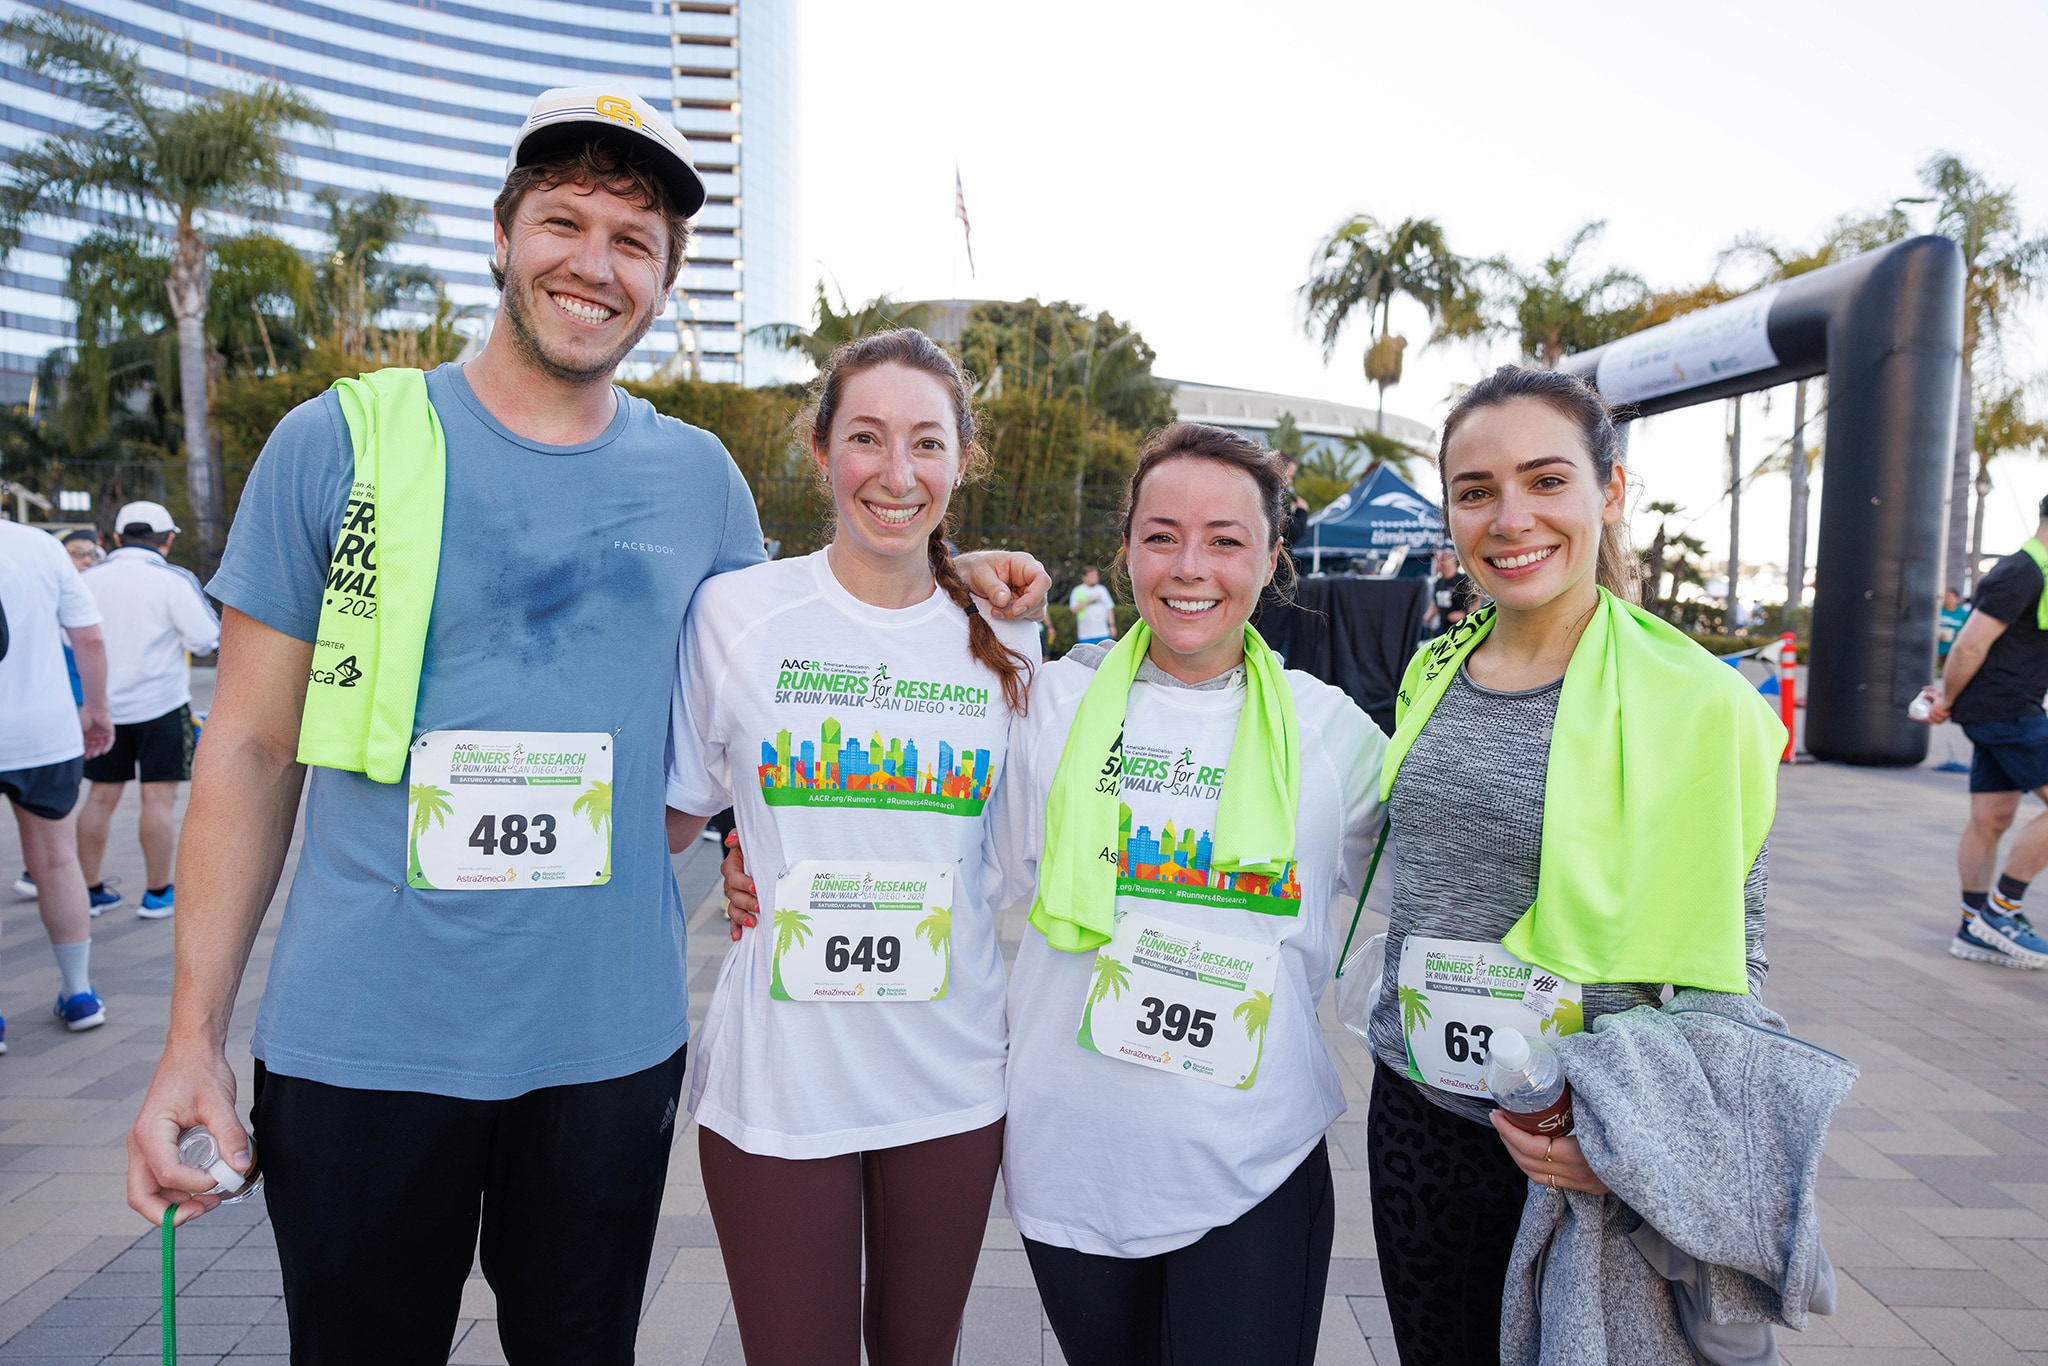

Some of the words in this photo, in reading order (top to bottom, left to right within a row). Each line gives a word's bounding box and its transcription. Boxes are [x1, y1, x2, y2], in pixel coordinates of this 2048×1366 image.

[342, 499, 376, 534] ER
[614, 541, 675, 555] FACEBOOK
[780, 658, 820, 671] AACR
[776, 671, 870, 695] RUNNERS
[865, 678, 892, 703] for
[894, 680, 988, 705] RESEARCH
[774, 690, 793, 704] 5K
[794, 692, 866, 708] RUN/WALK
[873, 696, 901, 711] SAN
[904, 699, 944, 714] DIEGO
[958, 703, 987, 718] 2024
[455, 743, 479, 751] AACR
[450, 764, 460, 772] 5K
[462, 765, 508, 773] RUN/WALK
[513, 766, 530, 774] SAN
[532, 766, 557, 774] DIEGO
[564, 766, 583, 774] 2024
[452, 752, 511, 764] RUNNERS
[507, 754, 524, 770] for
[526, 753, 586, 765] RESEARCH
[1163, 764, 1195, 788] for
[1095, 777, 1120, 797] SA
[1171, 783, 1202, 798] SAN
[809, 794, 876, 804] AACR.org/Runners
[886, 797, 955, 810] #Runners4Research
[468, 814, 557, 855] 483
[456, 874, 506, 883] AstraZeneca
[810, 891, 820, 899] 5K
[863, 892, 876, 900] SAN
[879, 892, 900, 900] DIEGO
[811, 880, 861, 891] RUNNERS
[858, 882, 873, 896] for
[874, 881, 927, 892] RESEARCH
[1116, 884, 1166, 895] .org/Runners
[1176, 890, 1247, 904] #Runners4Research
[1142, 928, 1164, 939] AACR
[825, 935, 901, 973] 649
[1137, 935, 1189, 957] RUNNERS
[1184, 948, 1200, 963] for
[1200, 951, 1254, 973] RESEARCH
[1135, 946, 1144, 955] 5K
[1145, 948, 1184, 965] RUN/WALK
[1187, 961, 1202, 970] SAN
[1203, 964, 1226, 976] DIEGO
[1232, 971, 1250, 981] 2024
[1425, 959, 1474, 974] RUNNERS
[1472, 965, 1487, 980] for
[1434, 973, 1473, 983] RUN/WALK
[1476, 978, 1491, 987] SAN
[1494, 980, 1518, 988] DIEGO
[1533, 976, 1558, 993] Hit
[1136, 996, 1217, 1048] 395
[1119, 1046, 1161, 1063] AstraZeneca
[1440, 1077, 1479, 1091] AstraZeneca
